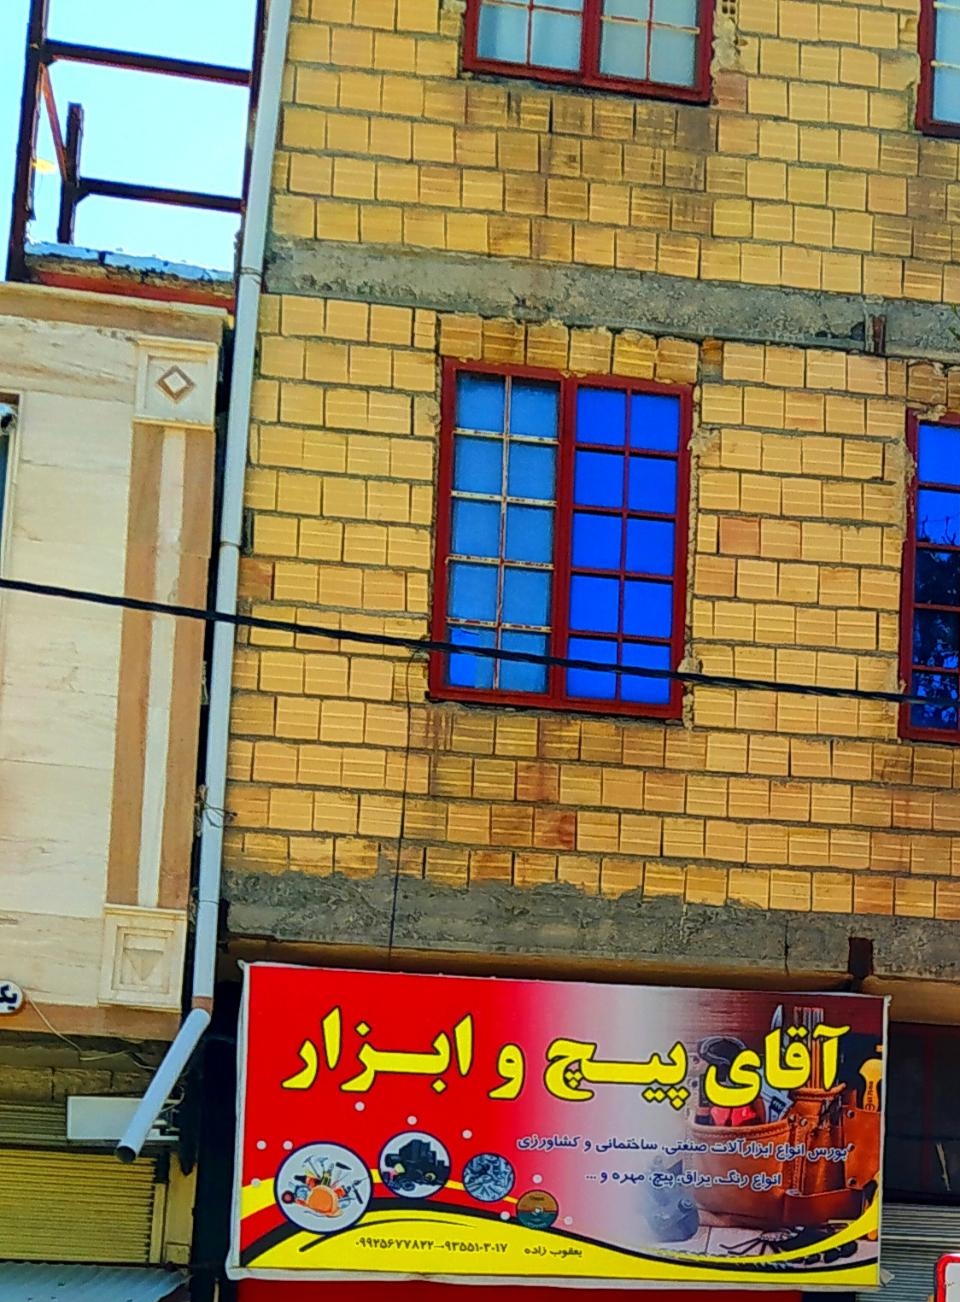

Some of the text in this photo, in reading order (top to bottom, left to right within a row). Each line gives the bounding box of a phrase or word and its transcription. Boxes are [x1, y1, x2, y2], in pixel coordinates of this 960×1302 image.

[281, 1005, 850, 1110] آقای پیچ و ابزار
[517, 1135, 580, 1151] کشاورزی
[583, 1138, 592, 1152] و
[595, 1137, 657, 1152] ساختمانی
[775, 1142, 804, 1160] انواع
[600, 1171, 608, 1184] و
[612, 1170, 645, 1183] مهره
[752, 1172, 782, 1190] انواع
[523, 1245, 547, 1257] زاده
[549, 1247, 583, 1260] یعقوب
